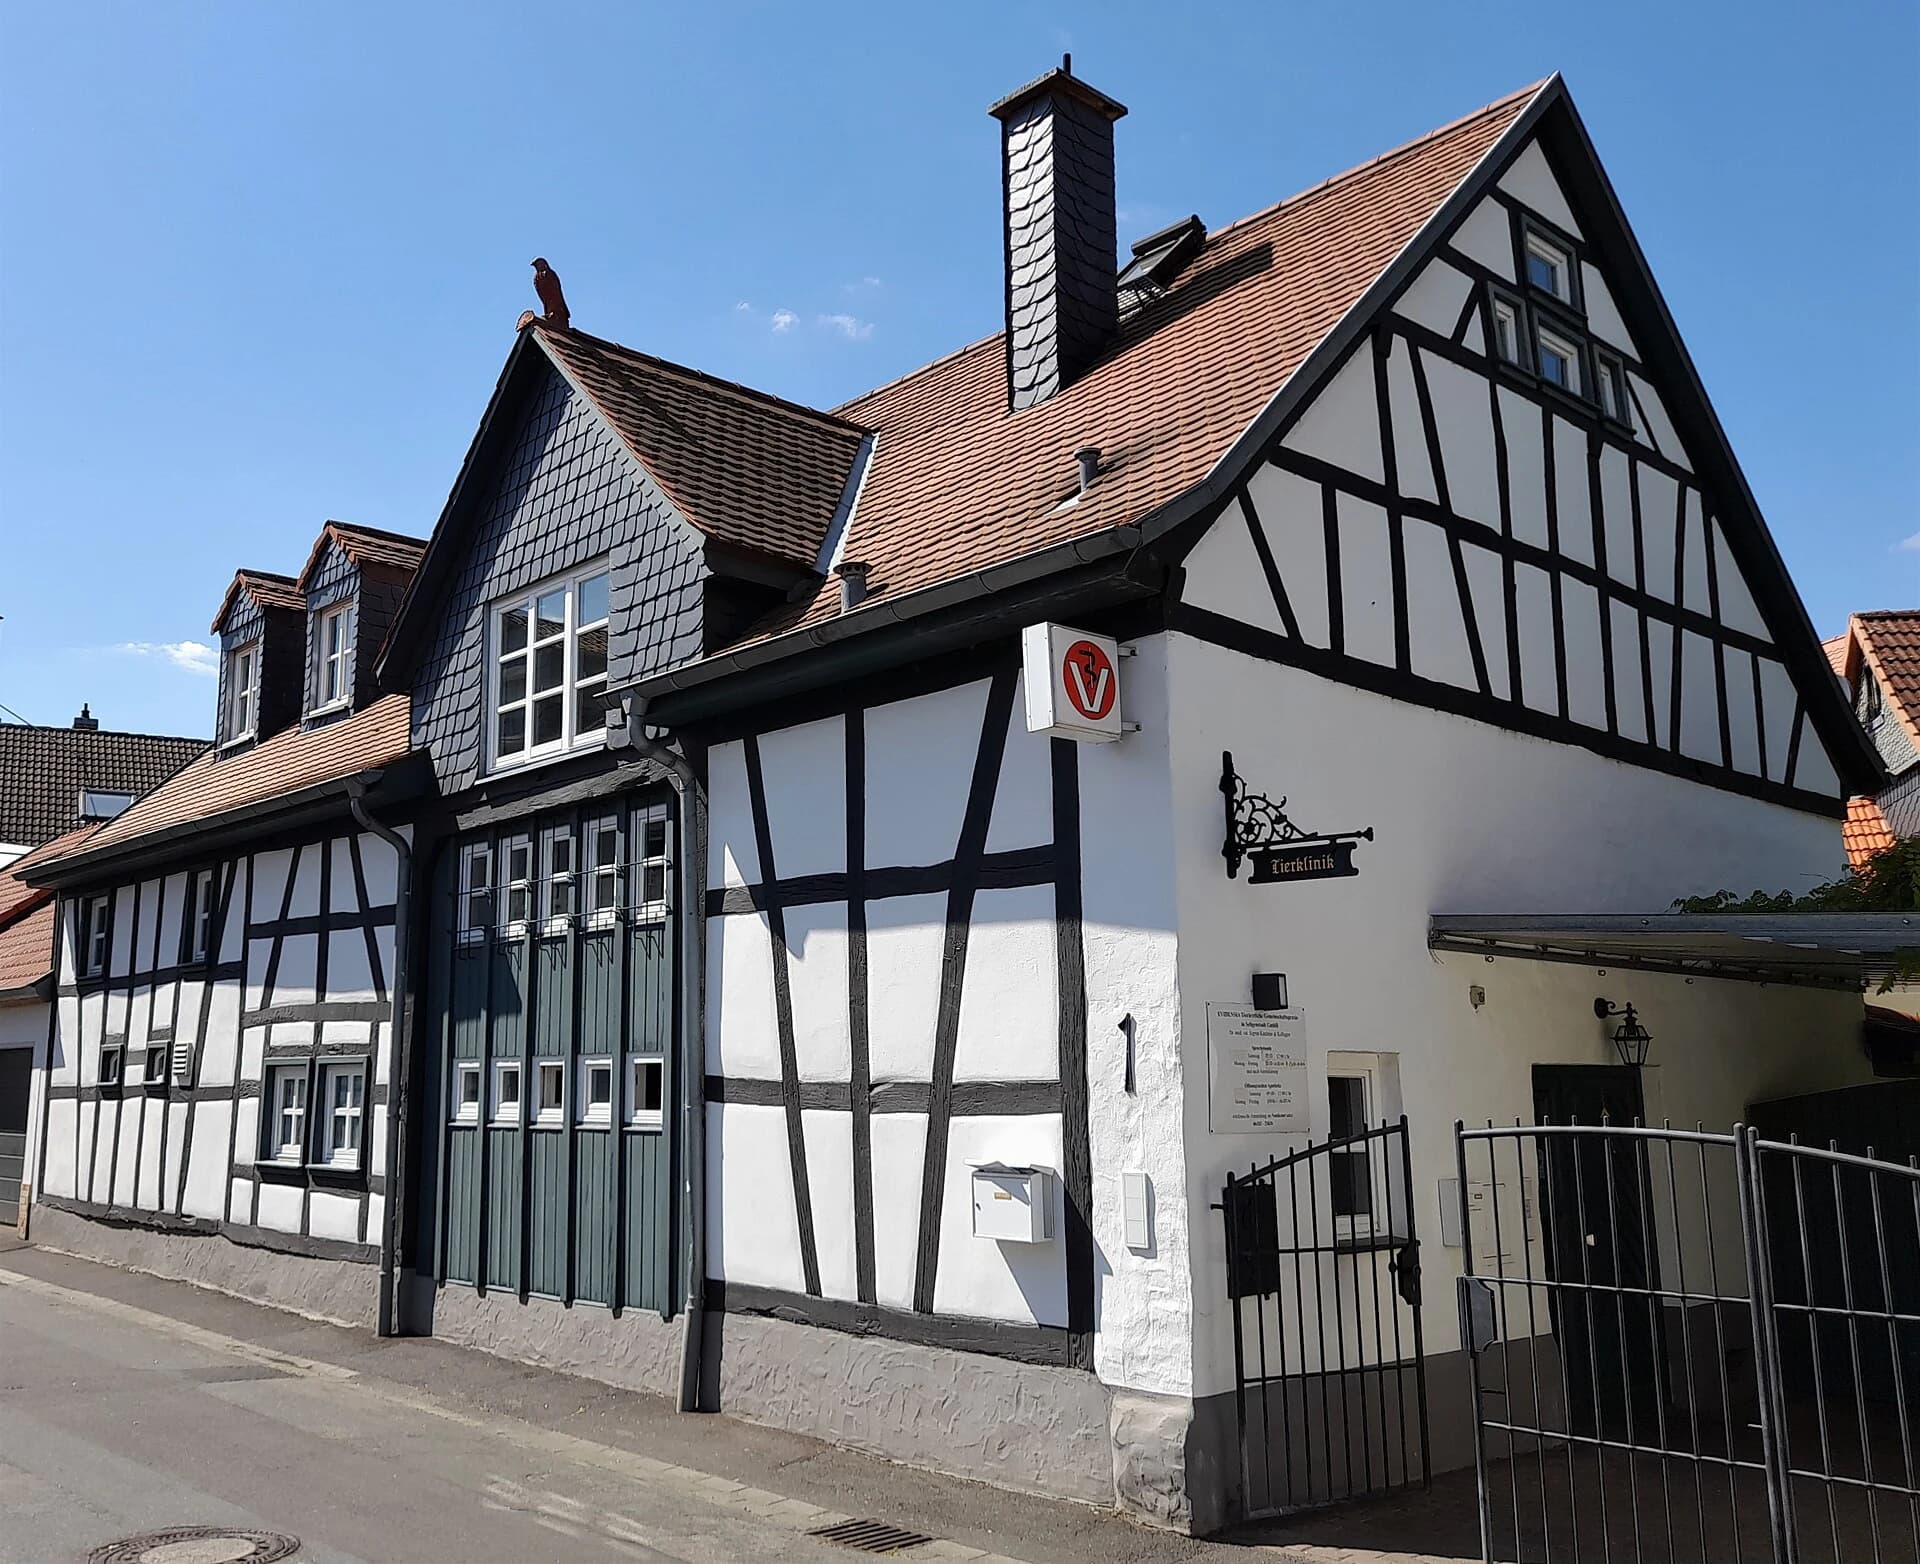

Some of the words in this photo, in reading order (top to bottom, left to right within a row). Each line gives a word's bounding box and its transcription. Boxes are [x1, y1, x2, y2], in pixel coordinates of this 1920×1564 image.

[1068, 660, 1110, 713] V
[1270, 854, 1334, 874] Tierklinik
[1117, 1012, 1133, 1092] 1
